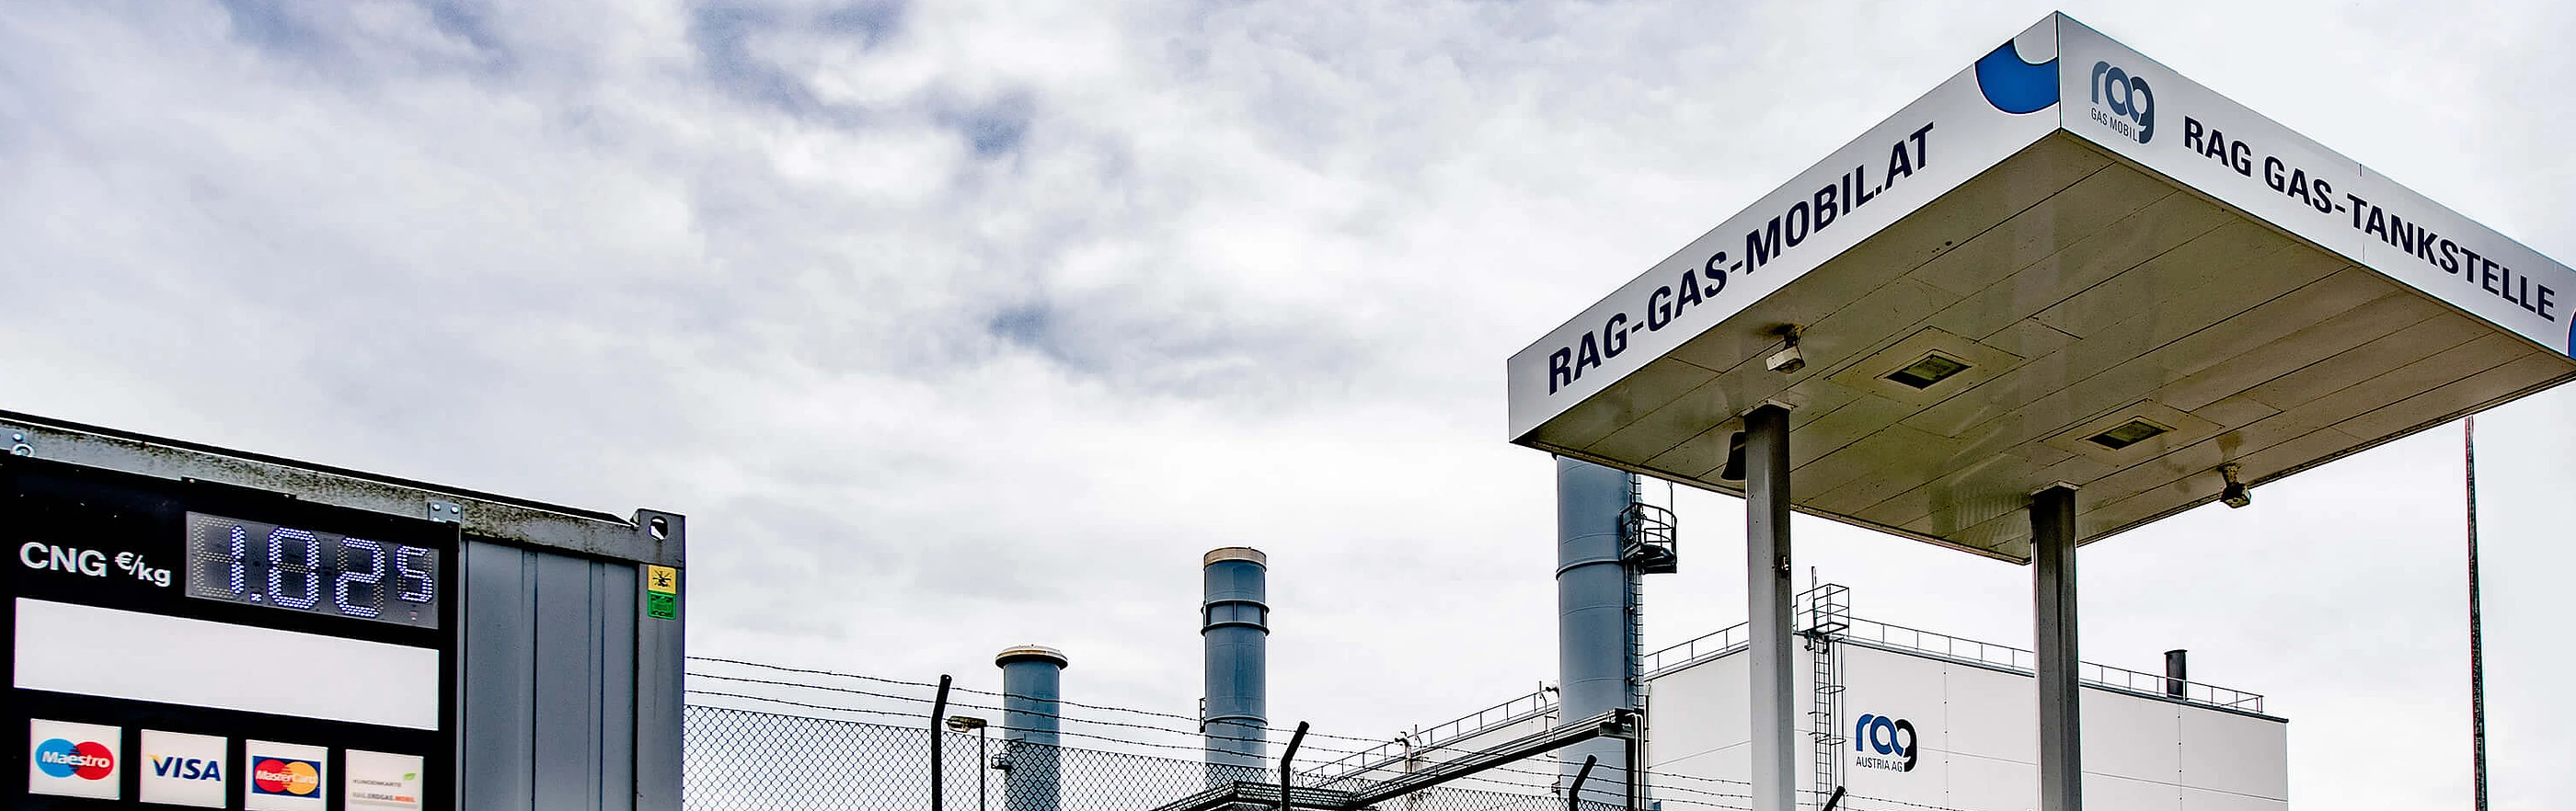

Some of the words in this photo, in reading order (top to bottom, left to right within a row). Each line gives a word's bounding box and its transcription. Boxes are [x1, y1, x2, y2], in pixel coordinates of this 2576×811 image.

[2091, 108, 2108, 126] GAS
[2110, 117, 2137, 142] MOBIL
[2184, 116, 2251, 177] RAG
[2264, 155, 2555, 323] GAS-TANKSTELLE
[1548, 121, 1934, 396] RAG-GAS-MOBIL.AT
[19, 542, 108, 577] CNG
[114, 552, 172, 588] €/kg
[41, 750, 110, 769] Maestro
[148, 755, 222, 782] VISA
[1856, 756, 1891, 771] AUSTRIA
[1892, 761, 1903, 772] AG
[255, 769, 319, 785] MasterCard
